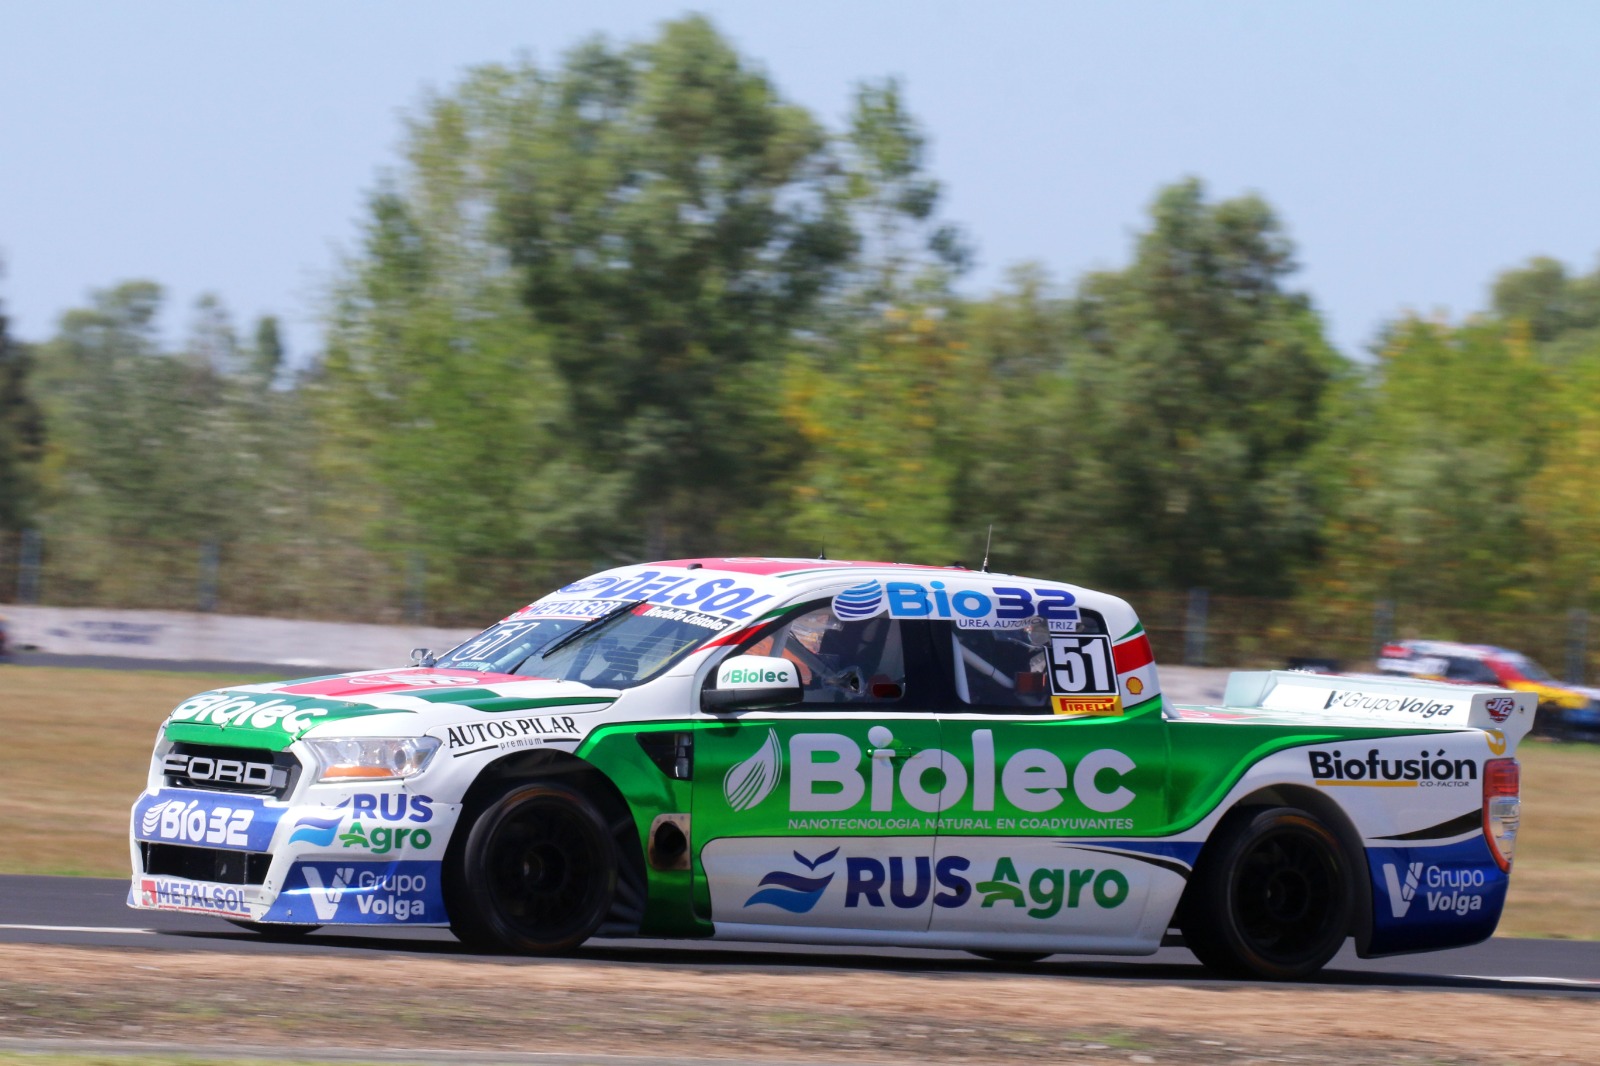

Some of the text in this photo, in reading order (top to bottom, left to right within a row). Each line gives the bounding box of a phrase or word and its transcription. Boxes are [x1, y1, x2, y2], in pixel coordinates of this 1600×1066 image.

[592, 571, 775, 620] DELSOL
[885, 580, 1078, 620] Bio32
[959, 619, 990, 628] UREA
[731, 668, 789, 683] Biolec
[1051, 637, 1110, 692] 51
[171, 695, 328, 733] Biolec
[1060, 698, 1115, 712] PIRELLI
[447, 716, 581, 748] AUTOS PILAR
[500, 737, 543, 750] premium
[162, 754, 273, 786] FORD
[788, 725, 1137, 813] Biolec
[1308, 749, 1477, 780] Biofusión
[160, 800, 254, 846] Bio32
[352, 793, 434, 822] RUS
[339, 821, 432, 854] Agro
[788, 818, 1134, 830] NANOTECNOLOGIA NATURAL EN COADYUVANTES
[358, 871, 426, 896] Grupo
[844, 856, 1129, 919] RUS Agro
[1427, 865, 1484, 891] Grupo
[156, 881, 250, 913] METALSOL
[356, 894, 425, 920] Volga
[1427, 891, 1482, 915] Volga
